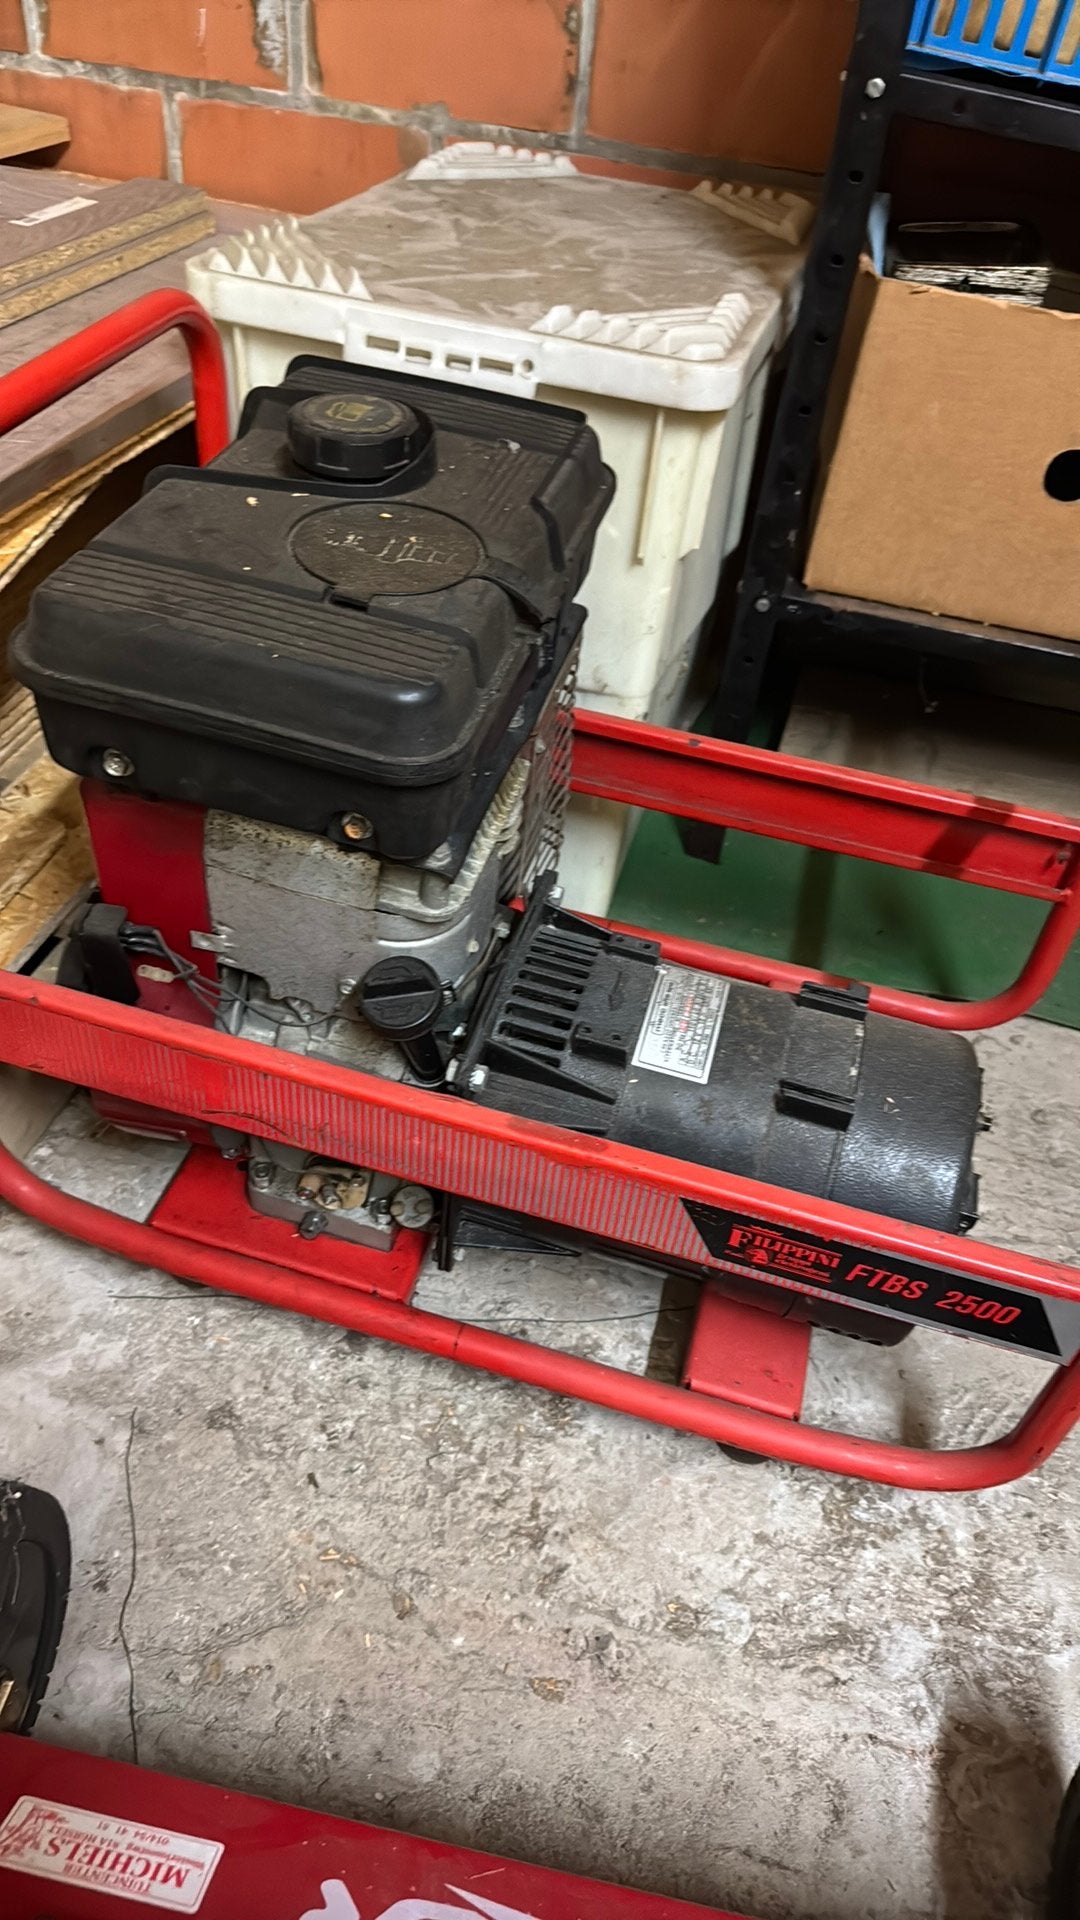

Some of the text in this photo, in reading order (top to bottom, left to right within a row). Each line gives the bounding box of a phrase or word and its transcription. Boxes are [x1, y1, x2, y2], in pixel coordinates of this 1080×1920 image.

[728, 1228, 841, 1269] FILIPPINI
[845, 1263, 929, 1299] FTBS
[935, 1290, 1022, 1325] 2500
[44, 1837, 190, 1889] MICHIELS
